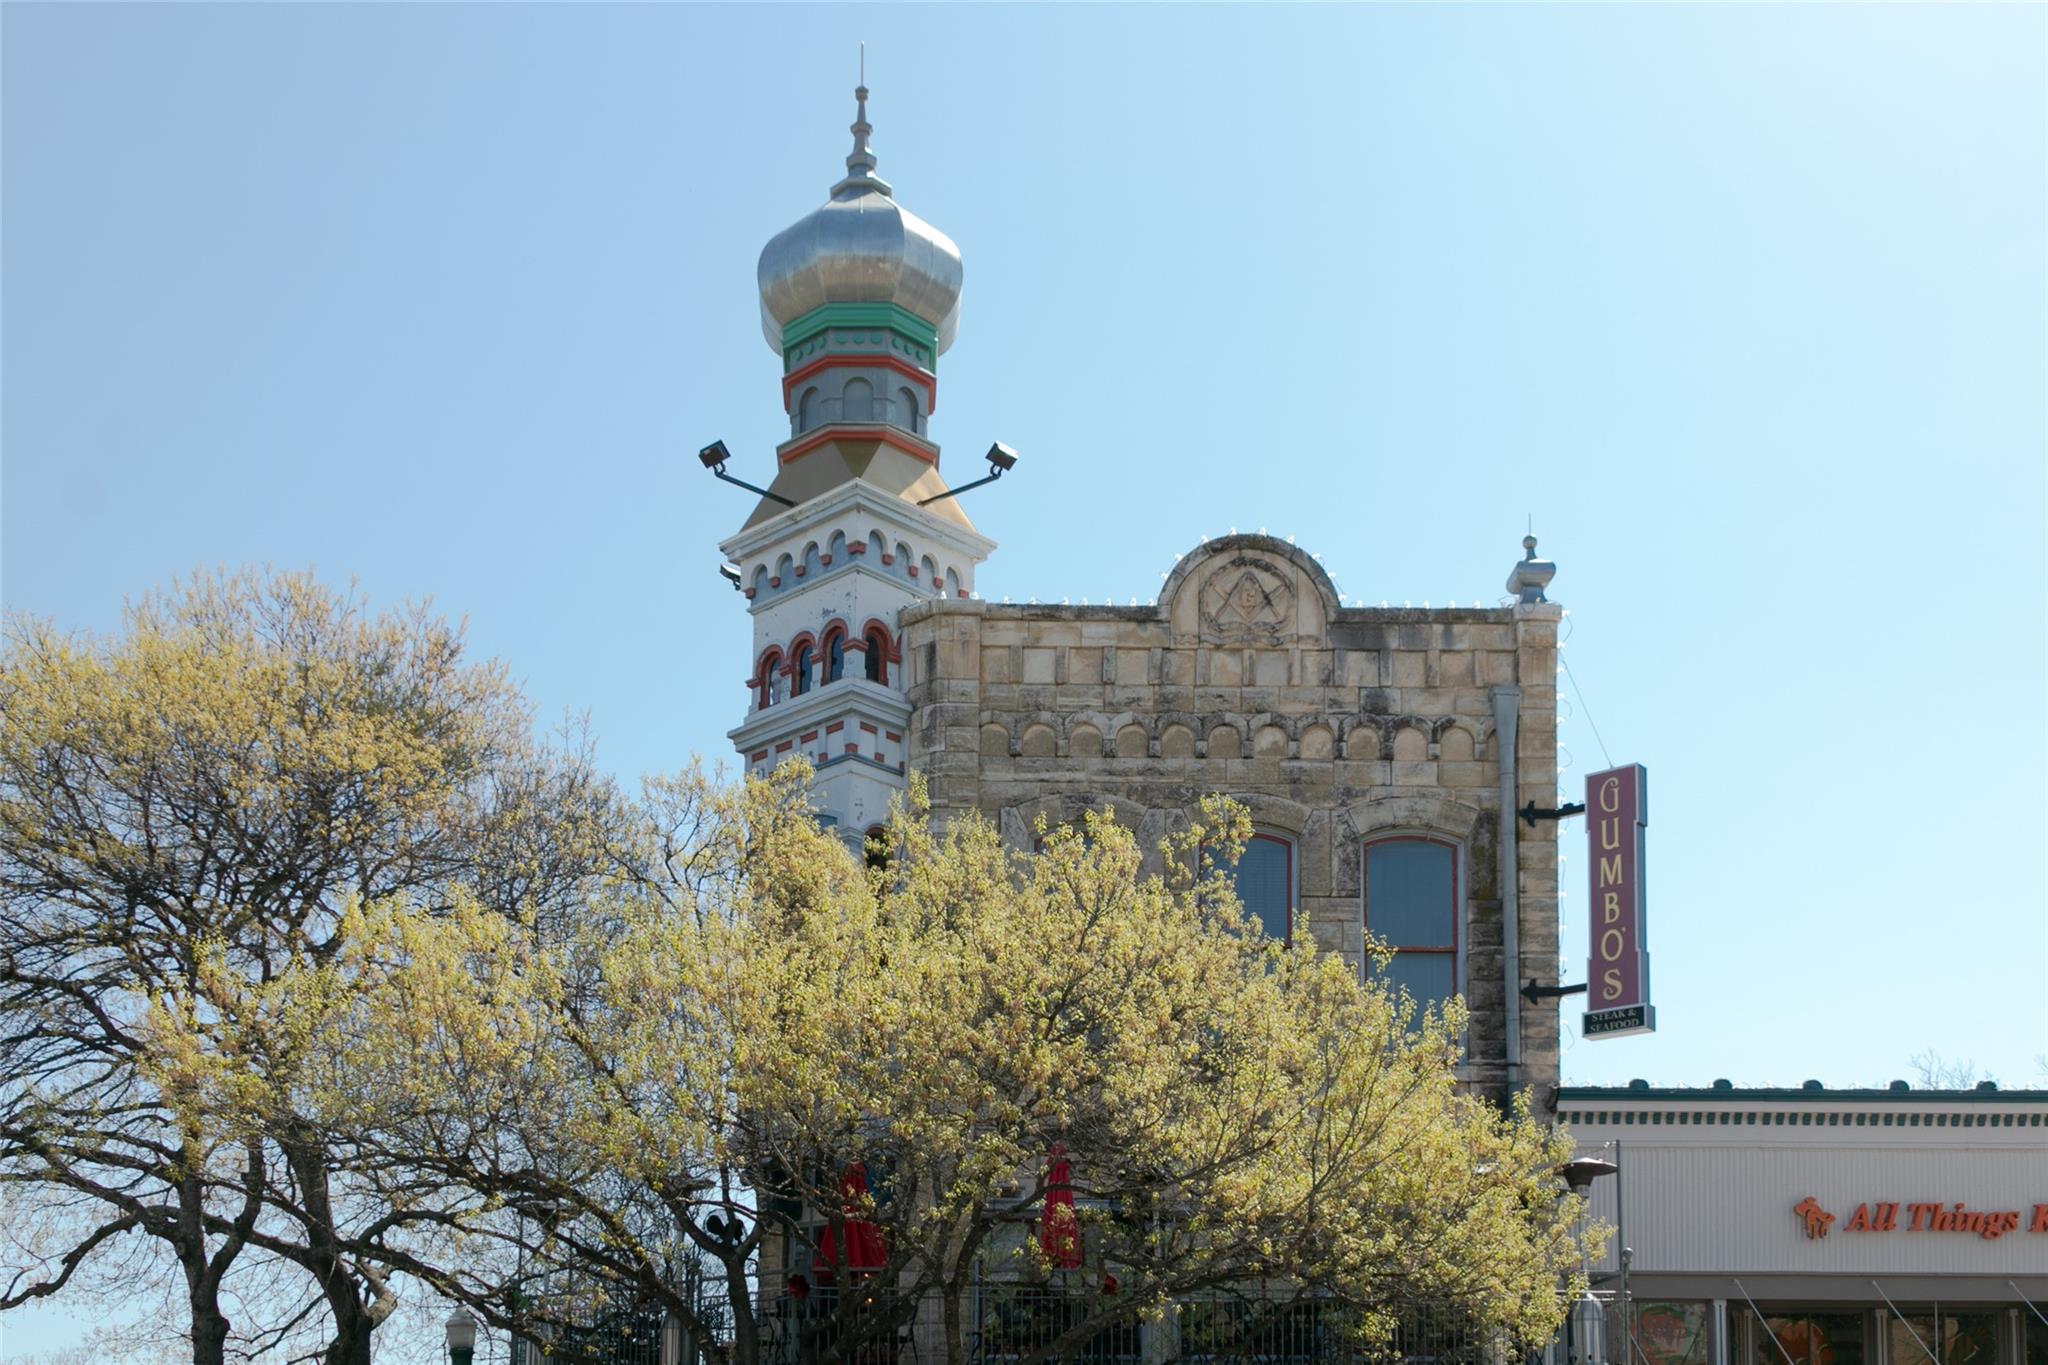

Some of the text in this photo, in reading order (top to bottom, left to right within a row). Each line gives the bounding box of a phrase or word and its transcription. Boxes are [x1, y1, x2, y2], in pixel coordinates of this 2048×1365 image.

[1591, 1009, 1626, 1022] STEAK
[1590, 1018, 1640, 1031] SEAFOOD
[1843, 1202, 1900, 1232] All
[1906, 1202, 2020, 1240] Things
